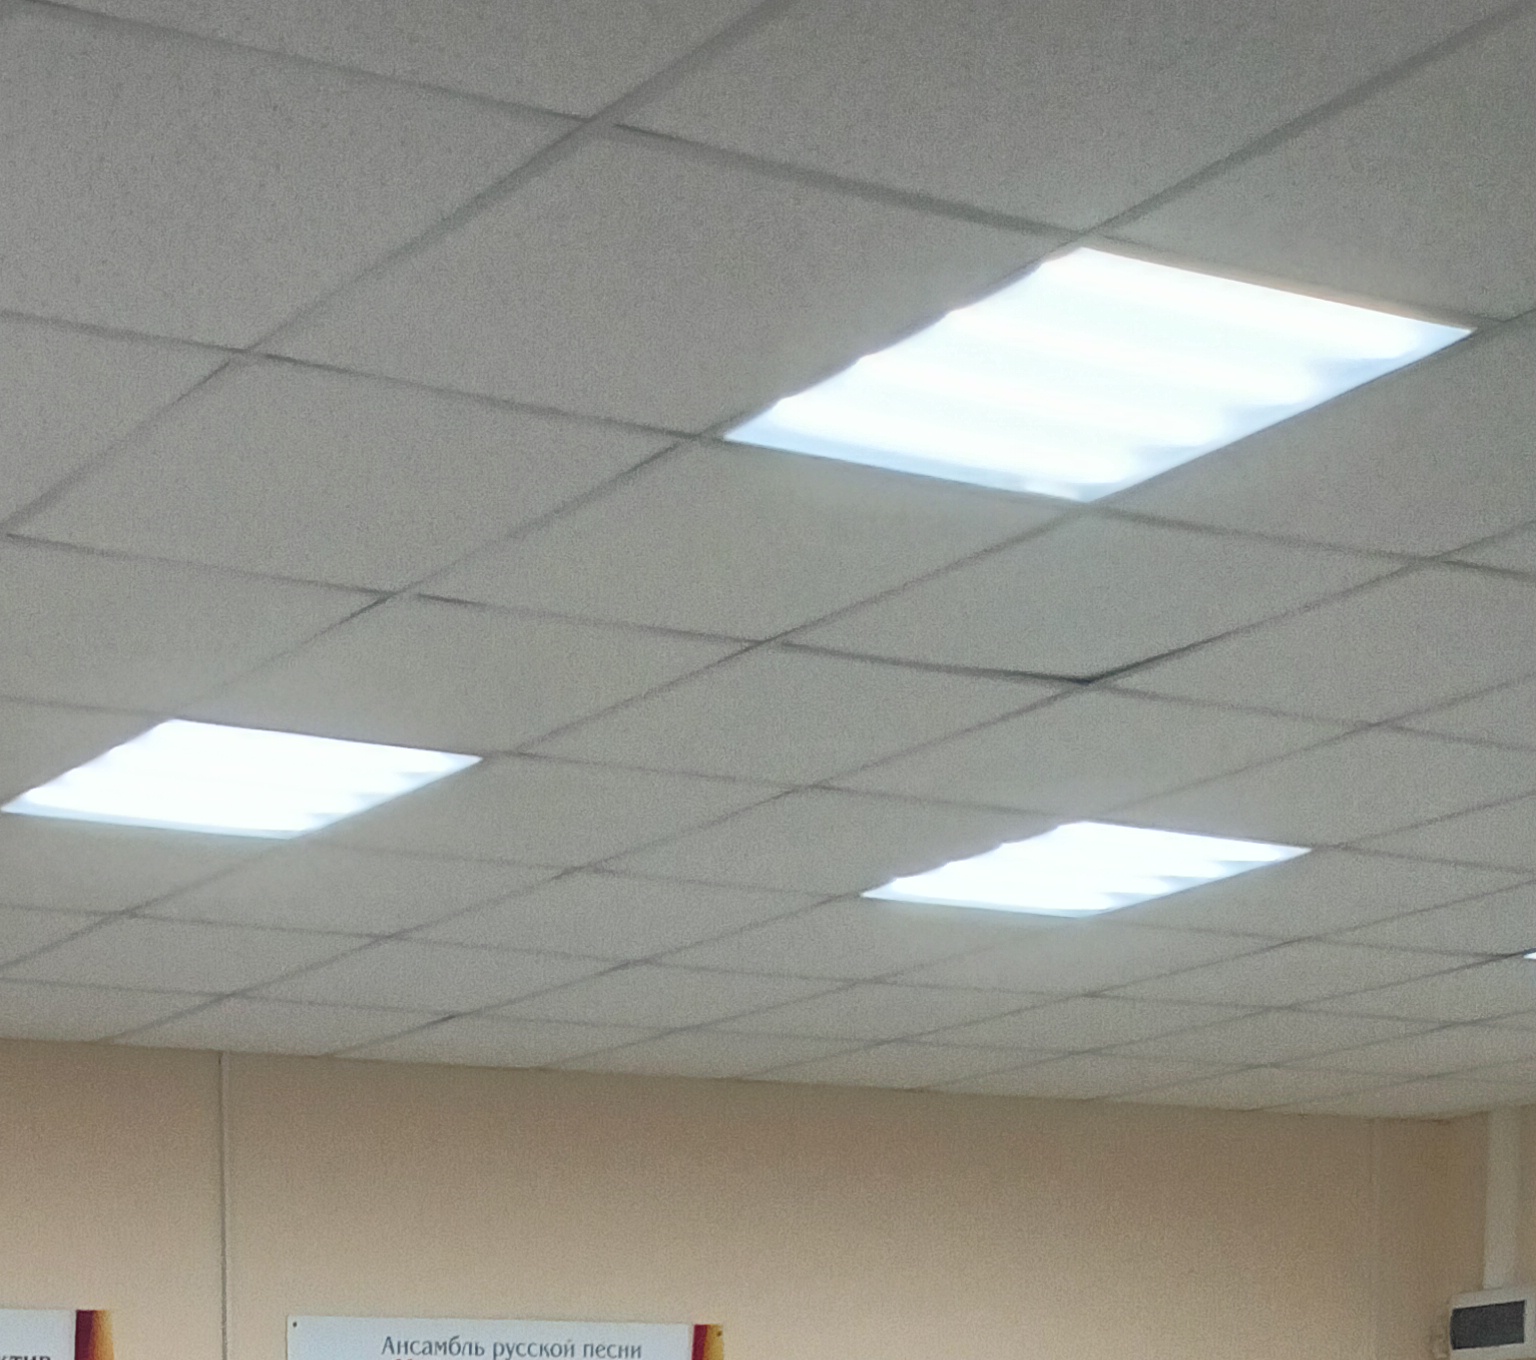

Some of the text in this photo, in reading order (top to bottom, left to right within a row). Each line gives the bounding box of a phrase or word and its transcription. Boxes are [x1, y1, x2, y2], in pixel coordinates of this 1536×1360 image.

[381, 1335, 642, 1360] Ансамбль русской песни
